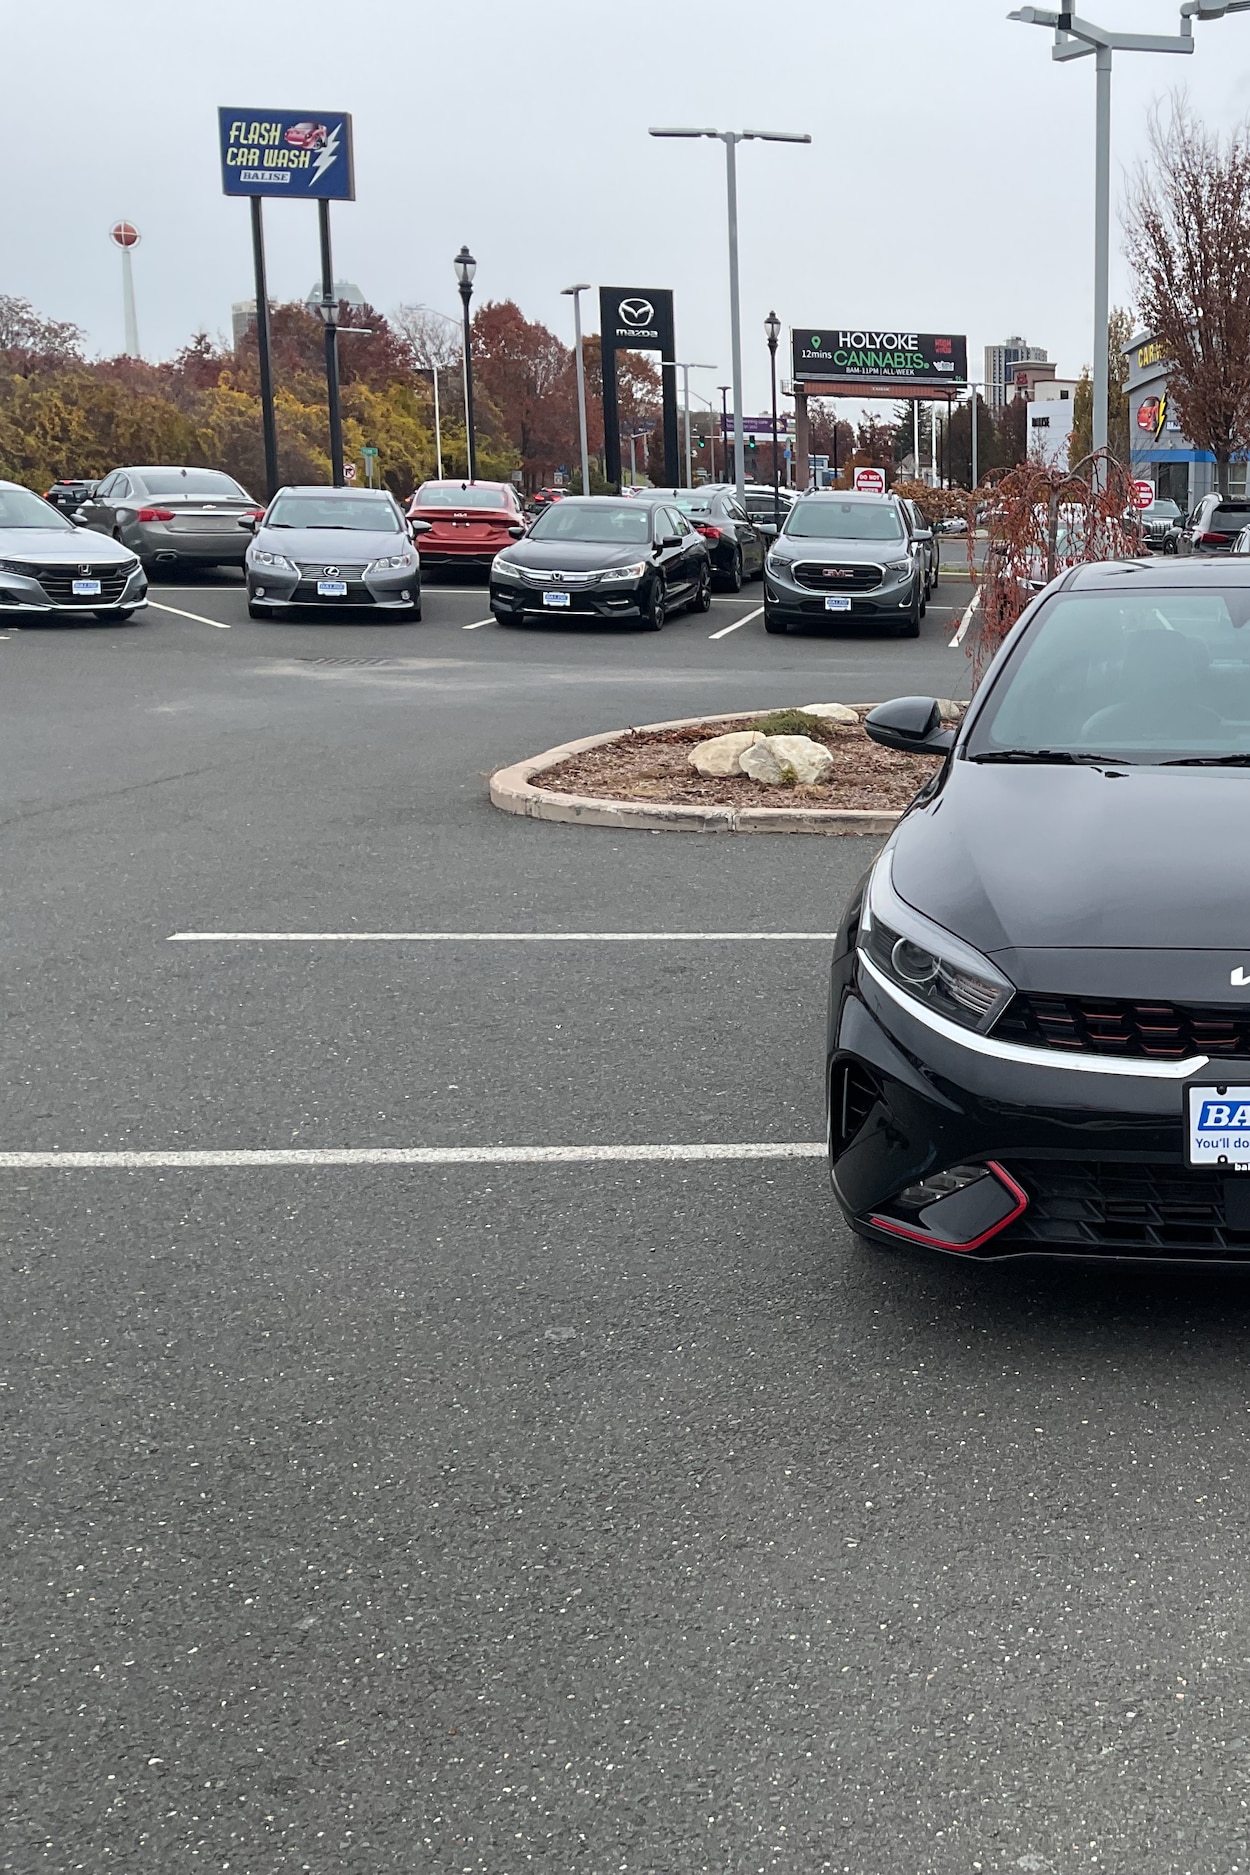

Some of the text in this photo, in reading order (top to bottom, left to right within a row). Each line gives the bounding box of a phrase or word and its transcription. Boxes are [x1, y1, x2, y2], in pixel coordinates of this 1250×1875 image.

[229, 121, 282, 145] FLASH
[226, 147, 311, 169] CAR WASH
[242, 171, 289, 181] BALISE
[838, 332, 918, 350] HOLYOKE
[801, 350, 832, 359] 12mins
[1138, 343, 1154, 368] CAR
[822, 568, 854, 577] GMC
[1195, 1137, 1229, 1148] You'll
[1233, 1138, 1250, 1148] do
